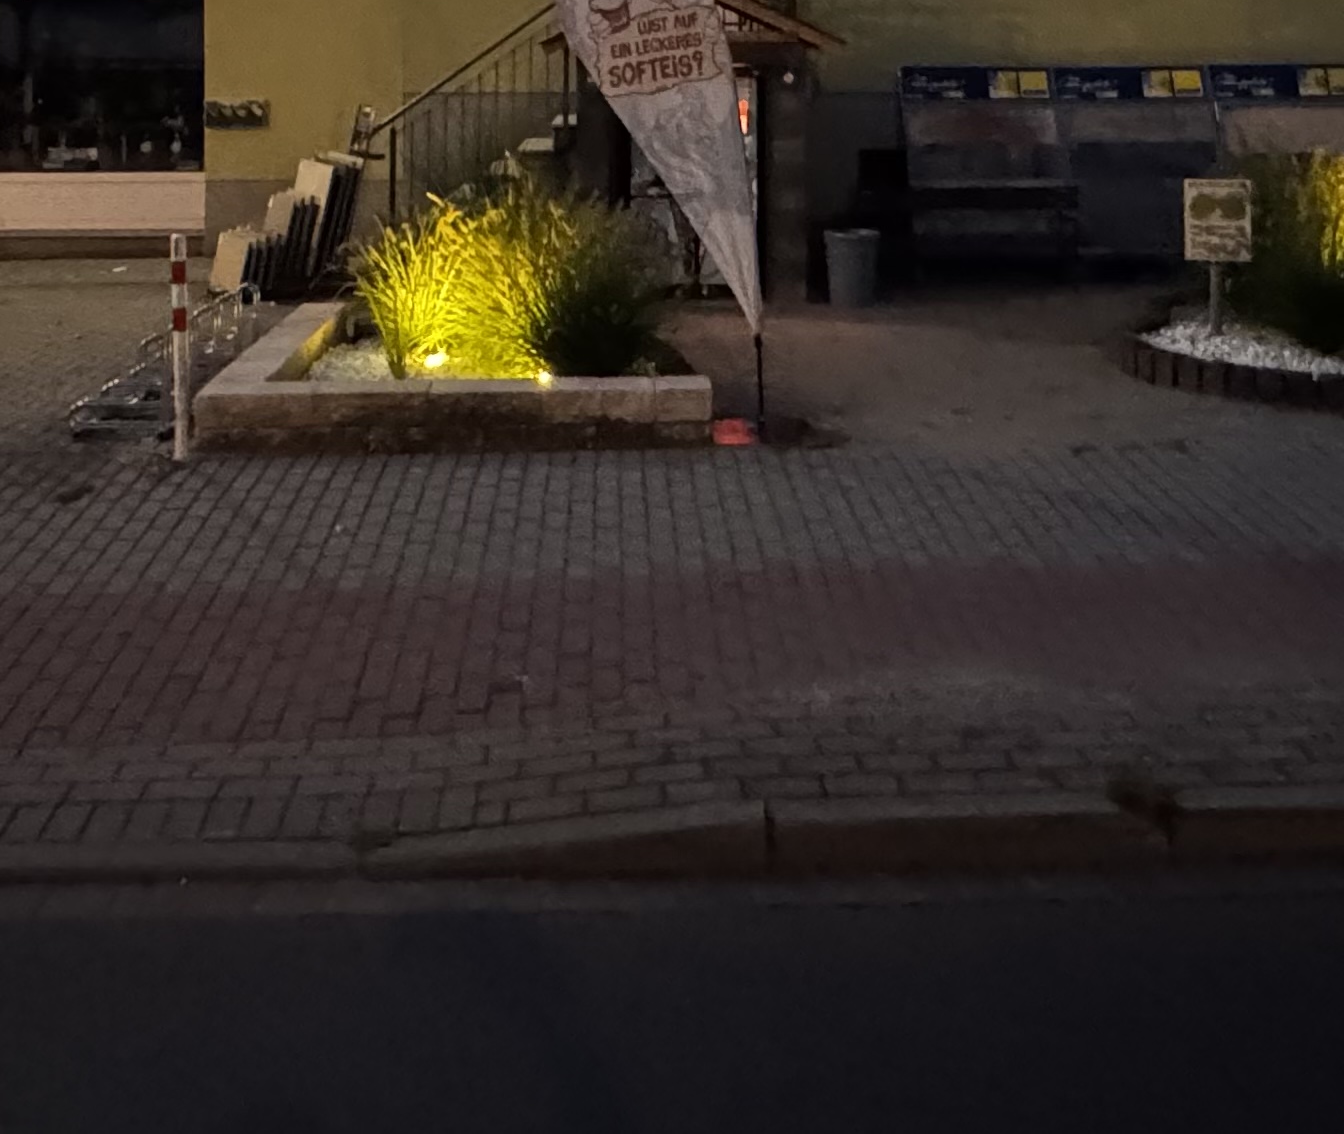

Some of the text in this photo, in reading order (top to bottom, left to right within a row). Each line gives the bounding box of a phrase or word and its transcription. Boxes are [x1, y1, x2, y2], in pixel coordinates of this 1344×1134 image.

[673, 12, 698, 29] AUF
[610, 31, 702, 59] EIN LECKERES
